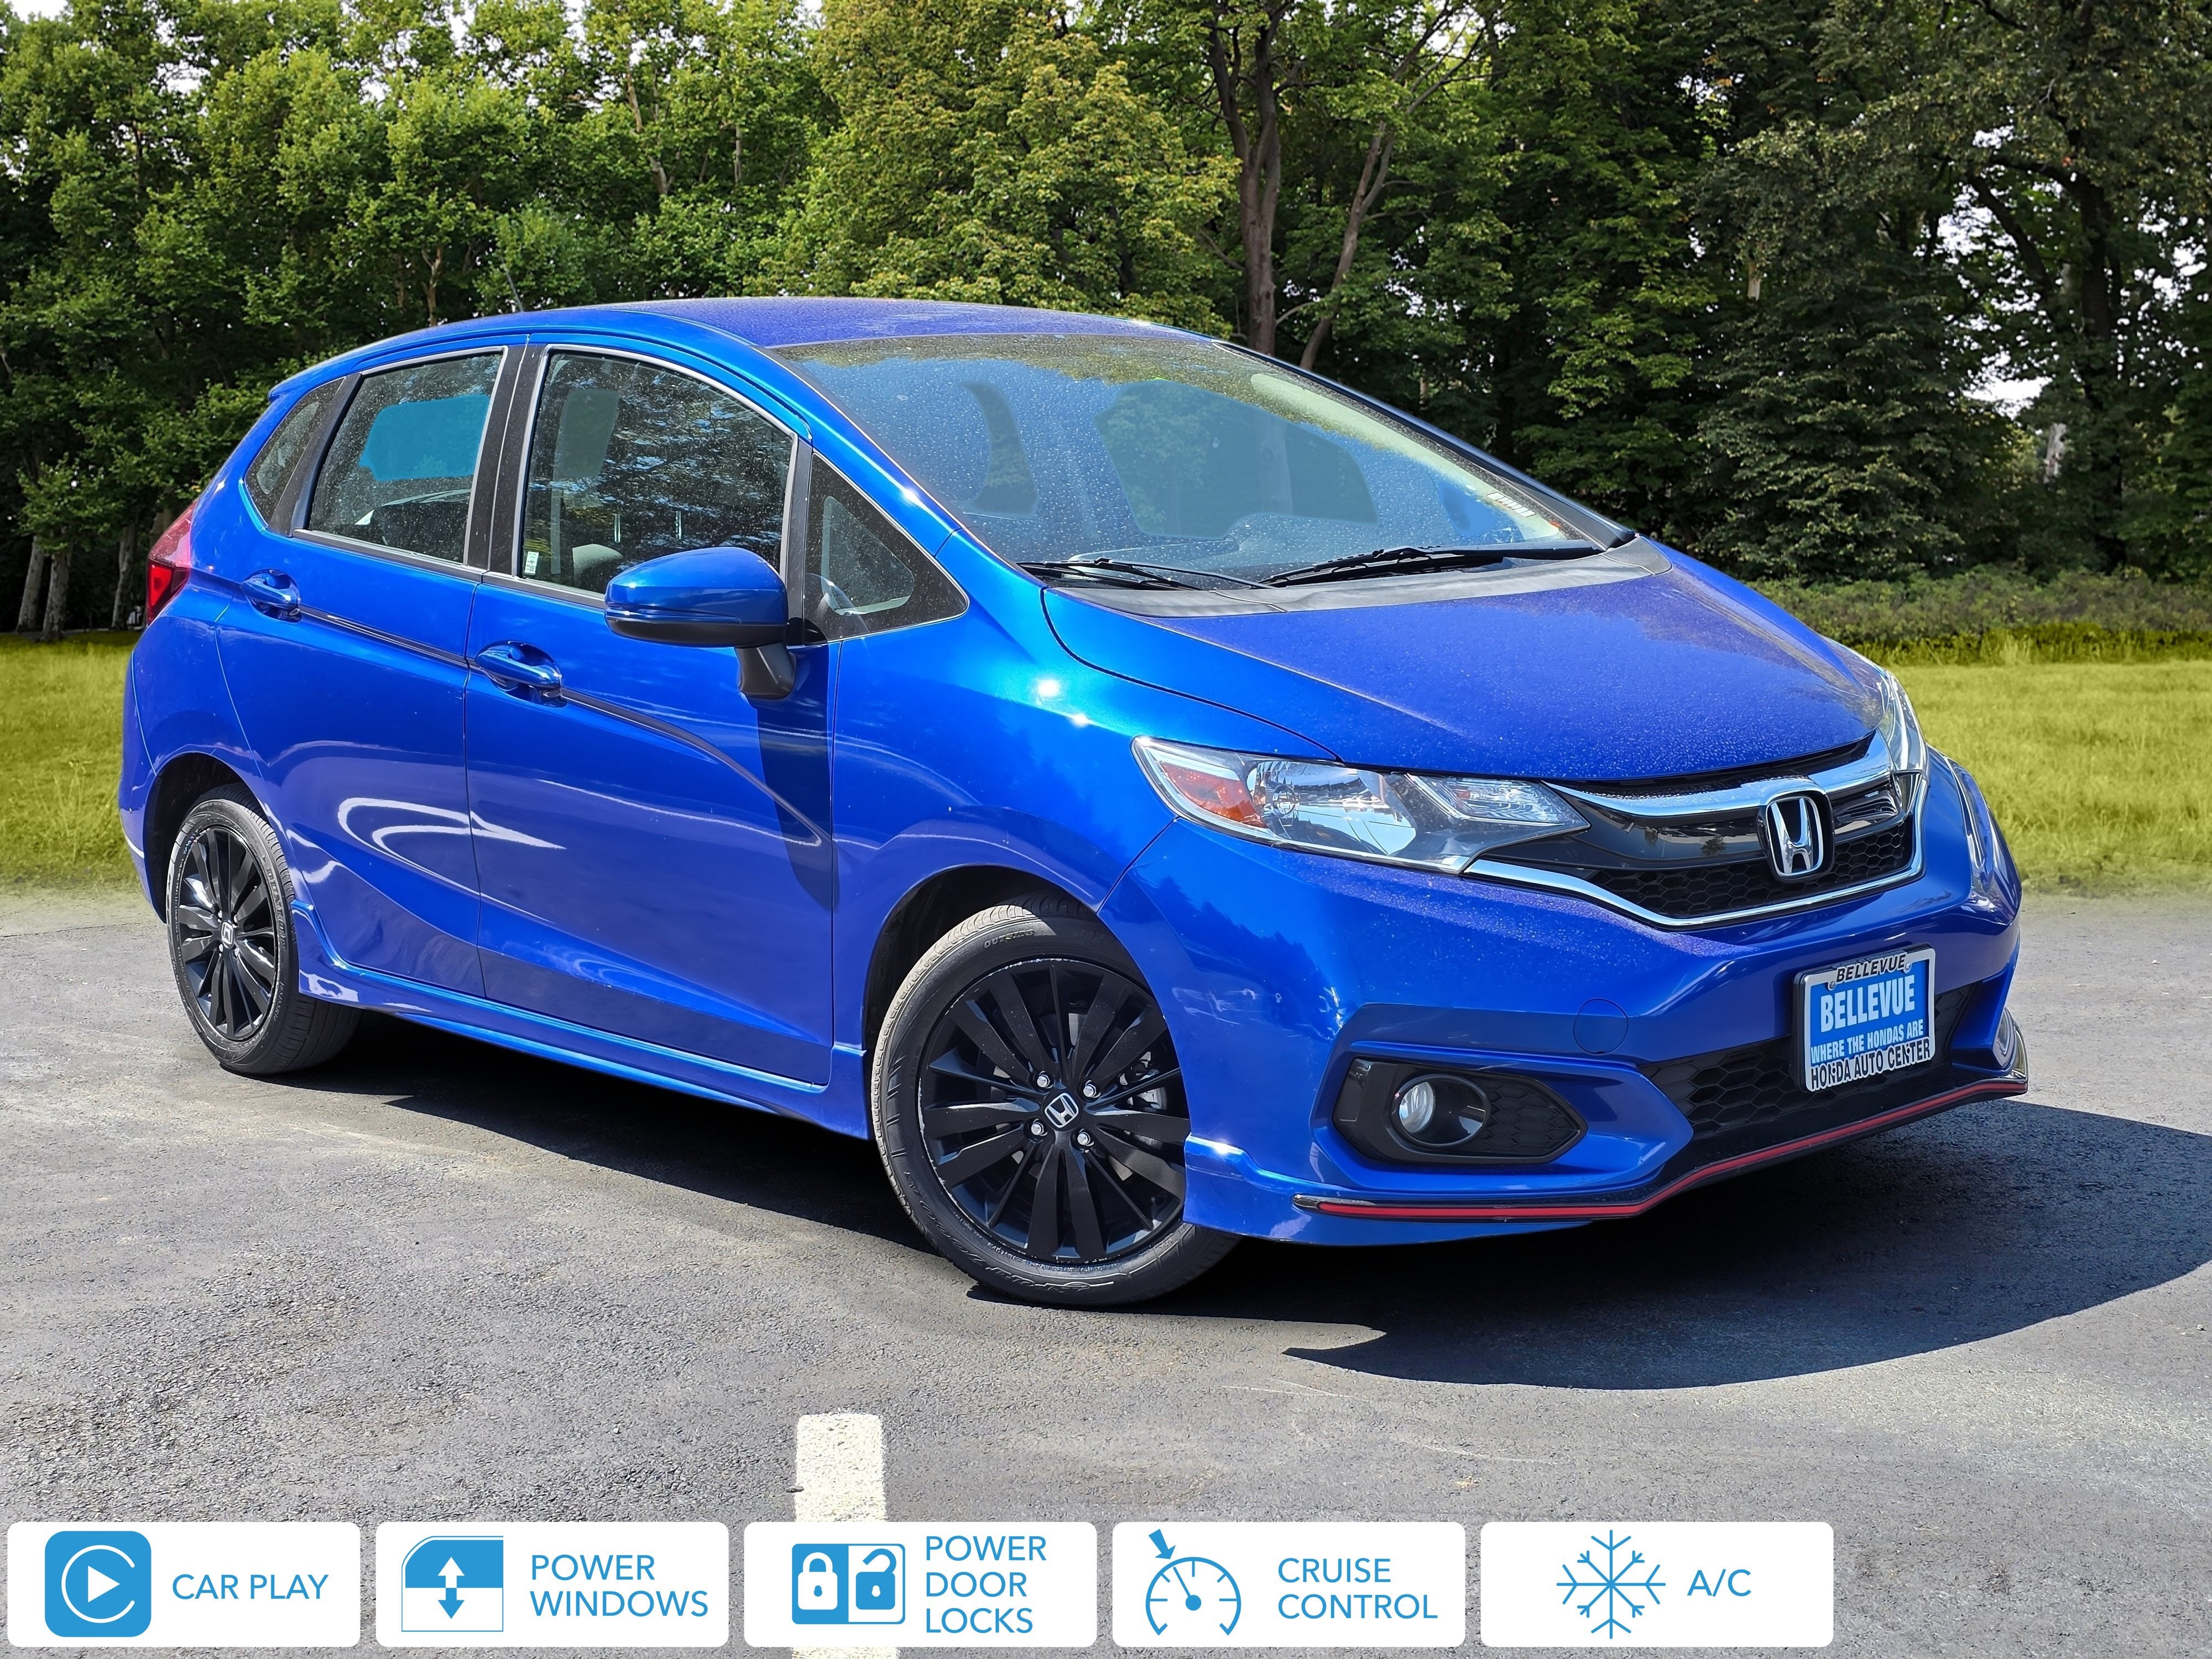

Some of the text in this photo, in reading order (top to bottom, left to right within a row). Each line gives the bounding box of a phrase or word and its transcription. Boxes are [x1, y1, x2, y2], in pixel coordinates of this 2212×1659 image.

[1836, 954, 1906, 983] BELLEVUE
[1820, 974, 1915, 1032] BELLEVUE
[1811, 1019, 1924, 1064] WHERE THE HONDAS ARE
[1811, 1038, 1931, 1089] HONDA AUTO CENTER
